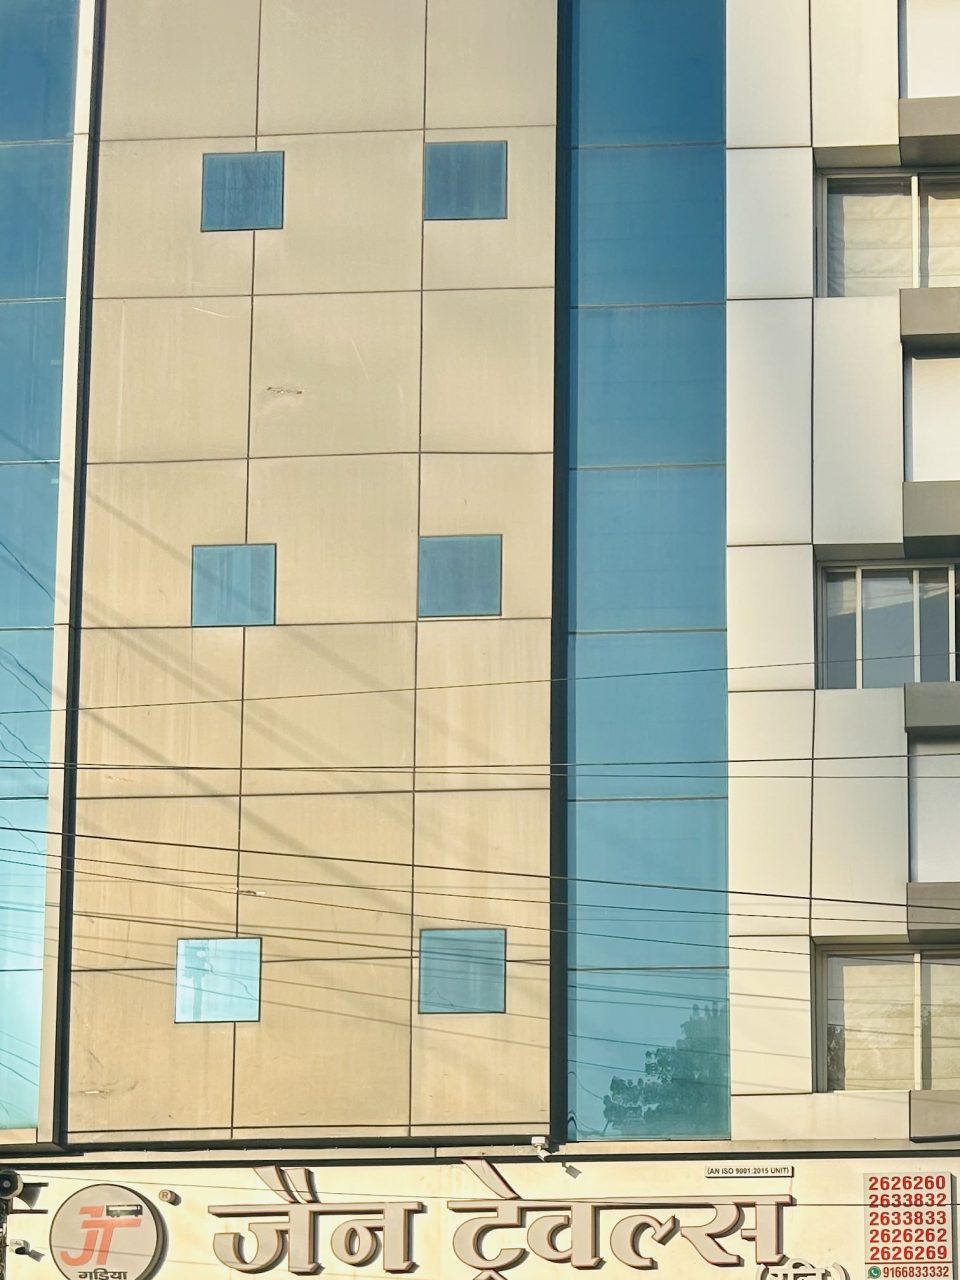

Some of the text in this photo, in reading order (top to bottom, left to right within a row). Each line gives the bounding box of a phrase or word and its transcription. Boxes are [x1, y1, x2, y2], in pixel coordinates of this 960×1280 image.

[707, 1167, 720, 1175] (AN
[735, 1167, 769, 1175] 9001:2015
[770, 1166, 790, 1175] UNIT)
[868, 1175, 945, 1190] 2626260
[868, 1193, 946, 1208] 2633832
[207, 1166, 424, 1275] जैन
[869, 1211, 946, 1225] 2633833
[869, 1229, 947, 1243] 2626262
[870, 1246, 947, 1261] 2626269
[883, 1266, 949, 1278] 9166833332
